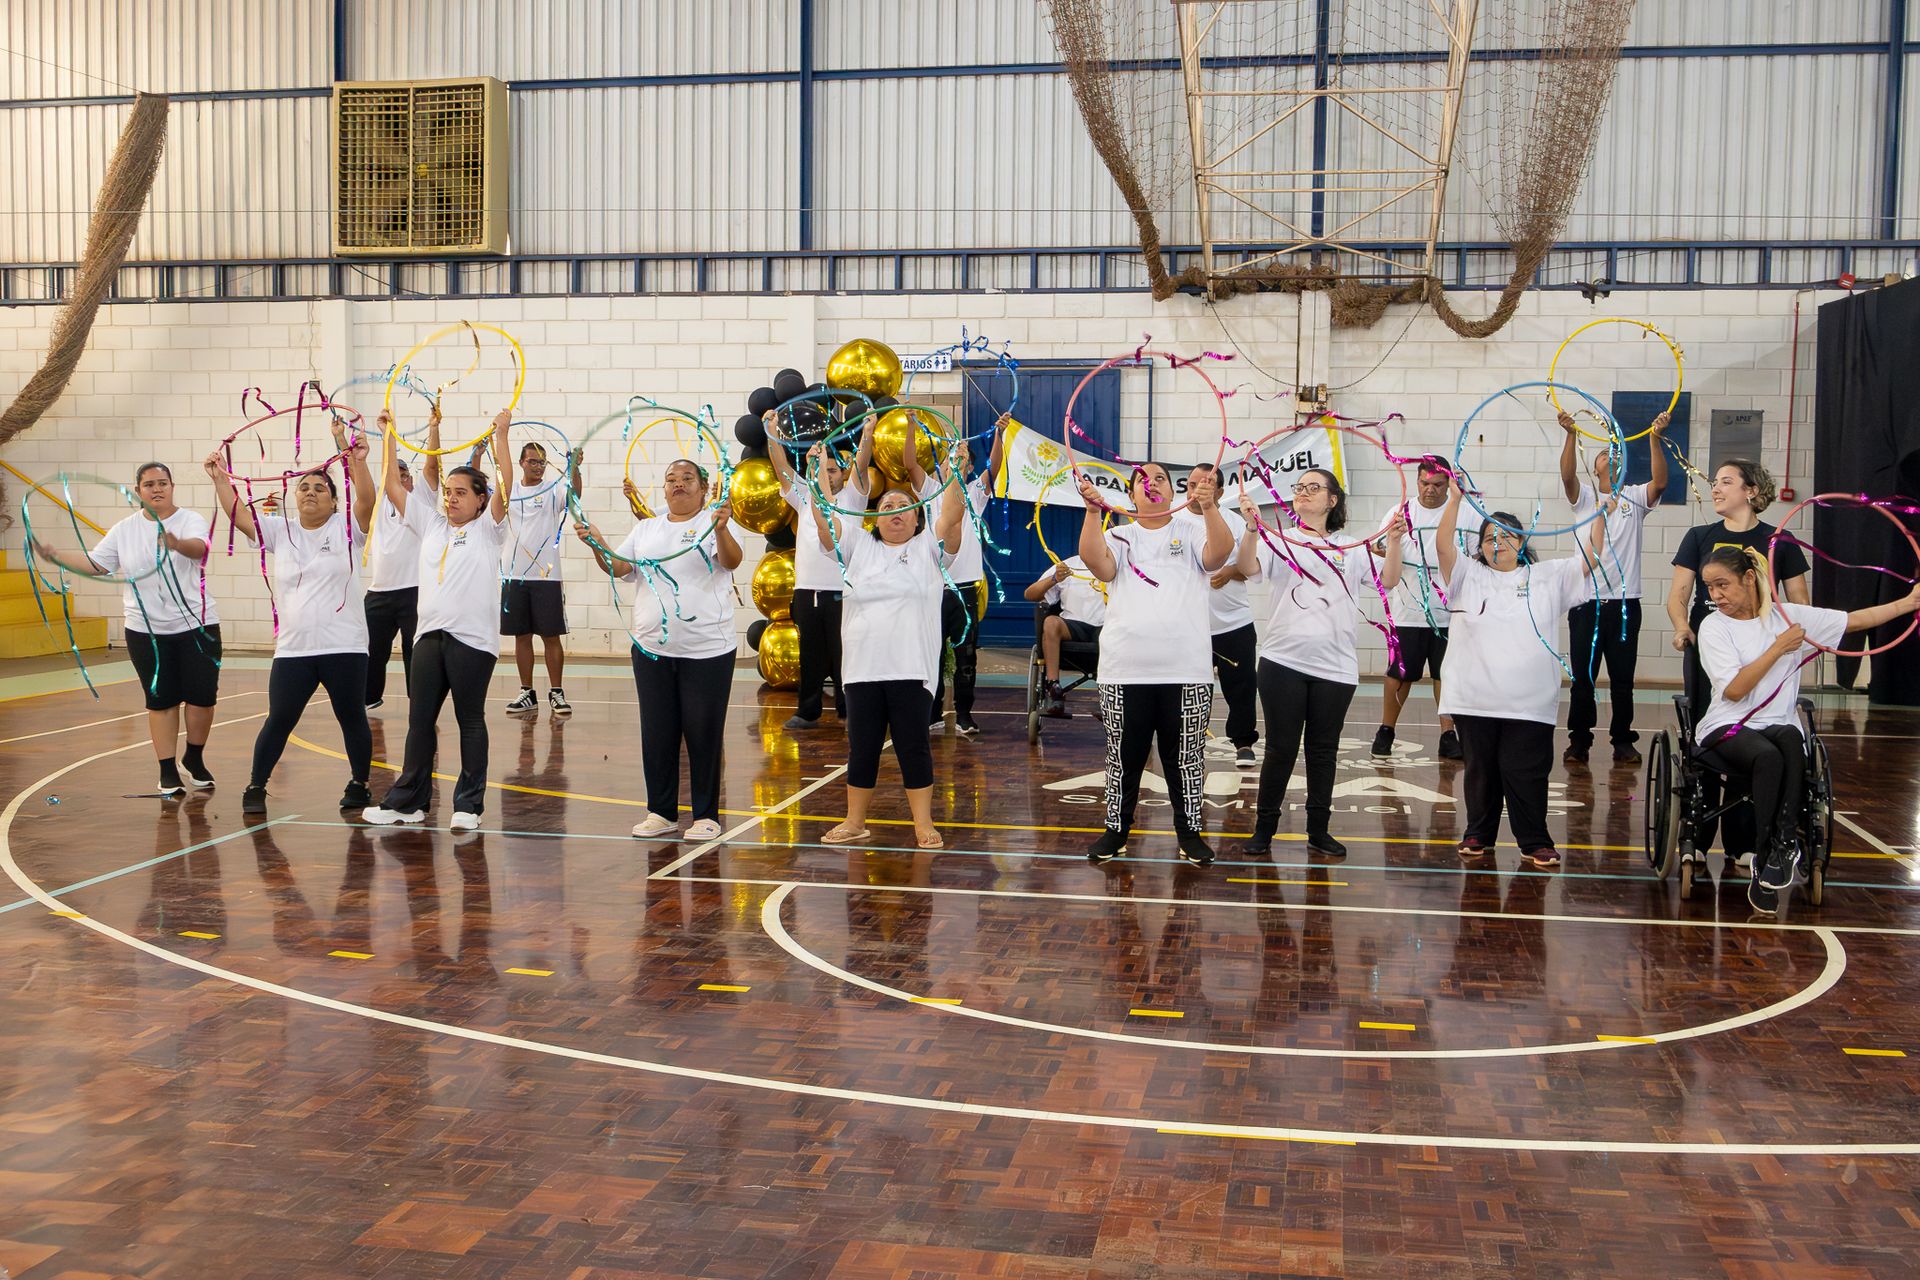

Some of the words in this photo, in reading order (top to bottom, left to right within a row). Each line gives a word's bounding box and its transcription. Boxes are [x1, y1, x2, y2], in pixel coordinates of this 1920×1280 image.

[900, 358, 932, 369] ÁRIOS
[1228, 450, 1320, 486] MANUEL
[1058, 794, 1172, 807] So
[1201, 799, 1413, 814] Muel
